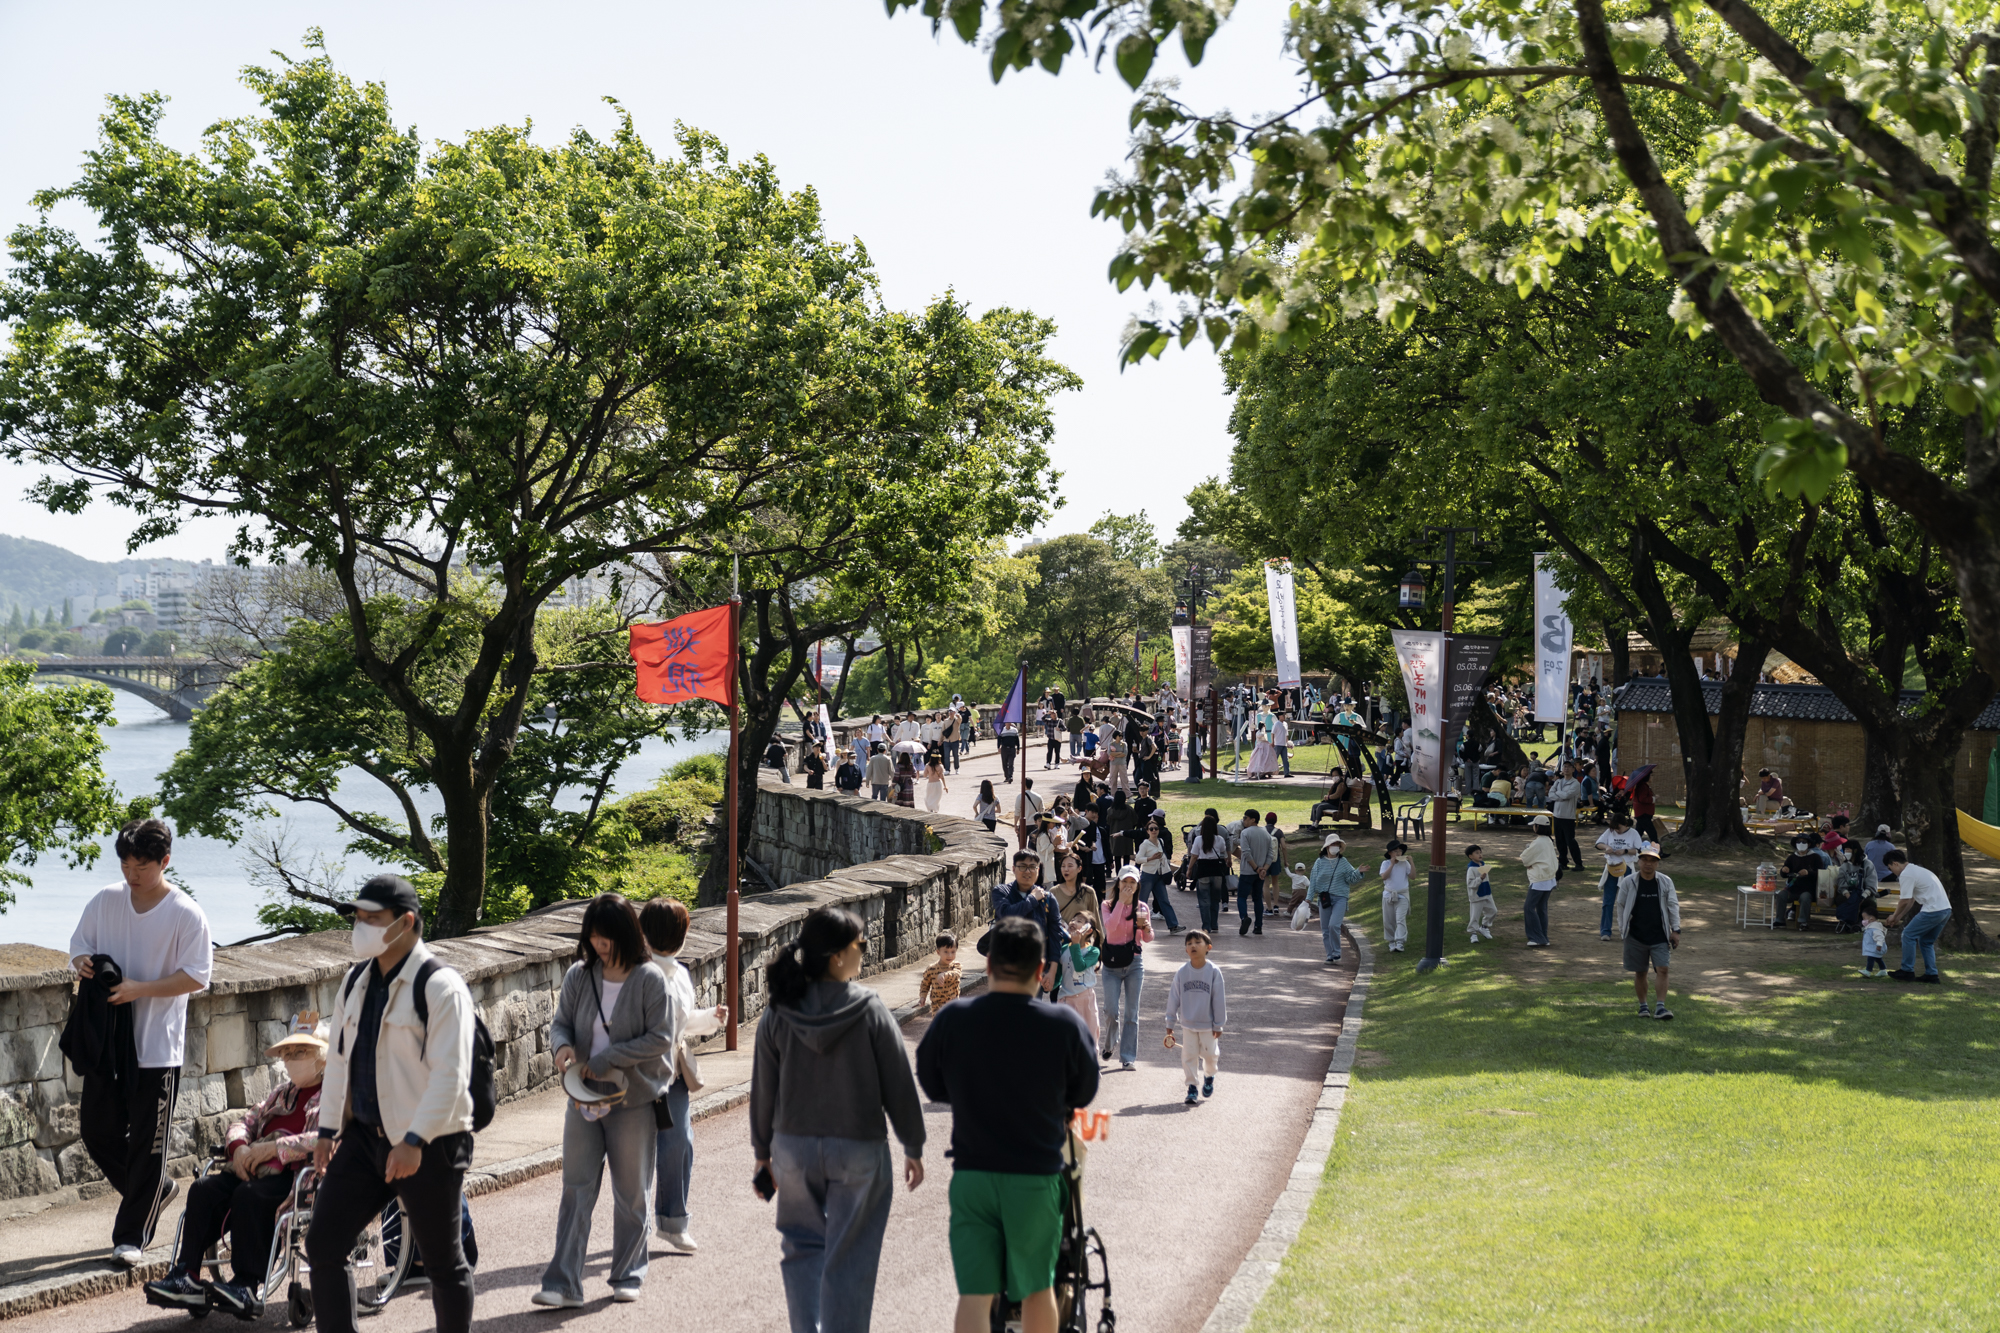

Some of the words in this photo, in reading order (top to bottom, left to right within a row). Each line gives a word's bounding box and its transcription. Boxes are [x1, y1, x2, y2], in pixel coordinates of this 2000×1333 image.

[1410, 660, 1426, 669] 진주
[1456, 663, 1478, 671] 05.03.
[1453, 684, 1474, 692] 05.06.
